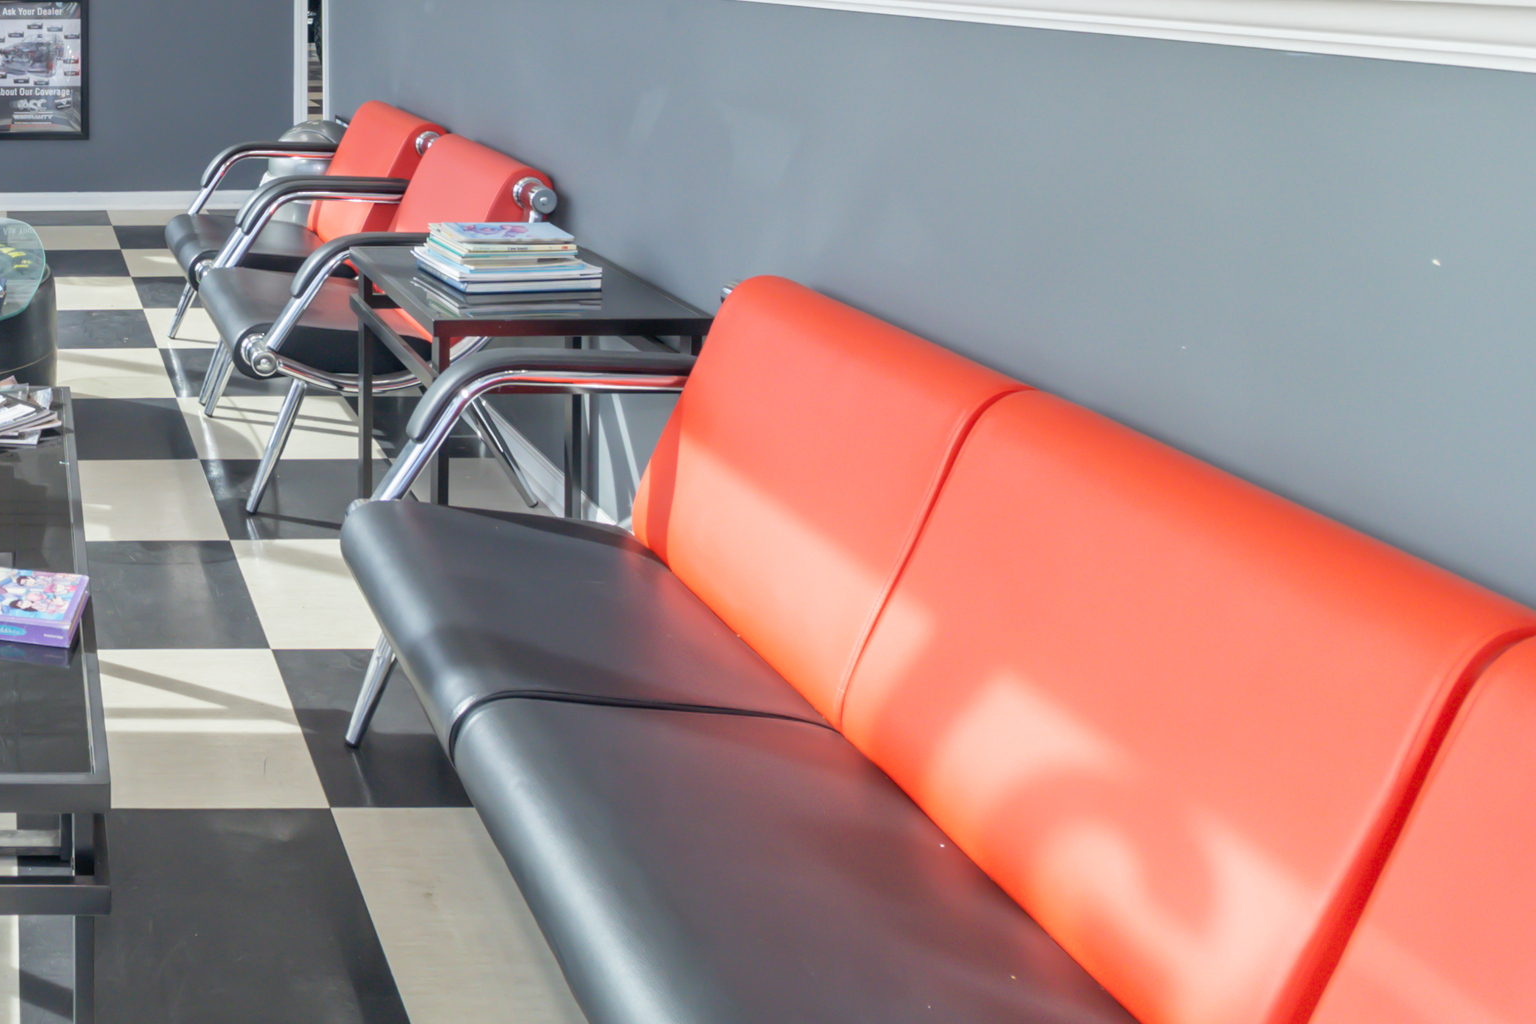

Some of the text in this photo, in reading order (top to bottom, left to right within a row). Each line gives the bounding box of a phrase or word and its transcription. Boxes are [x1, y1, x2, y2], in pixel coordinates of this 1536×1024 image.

[2, 7, 63, 16] Ask Your Dealer
[19, 88, 33, 97] Our
[35, 88, 71, 98] Coverage
